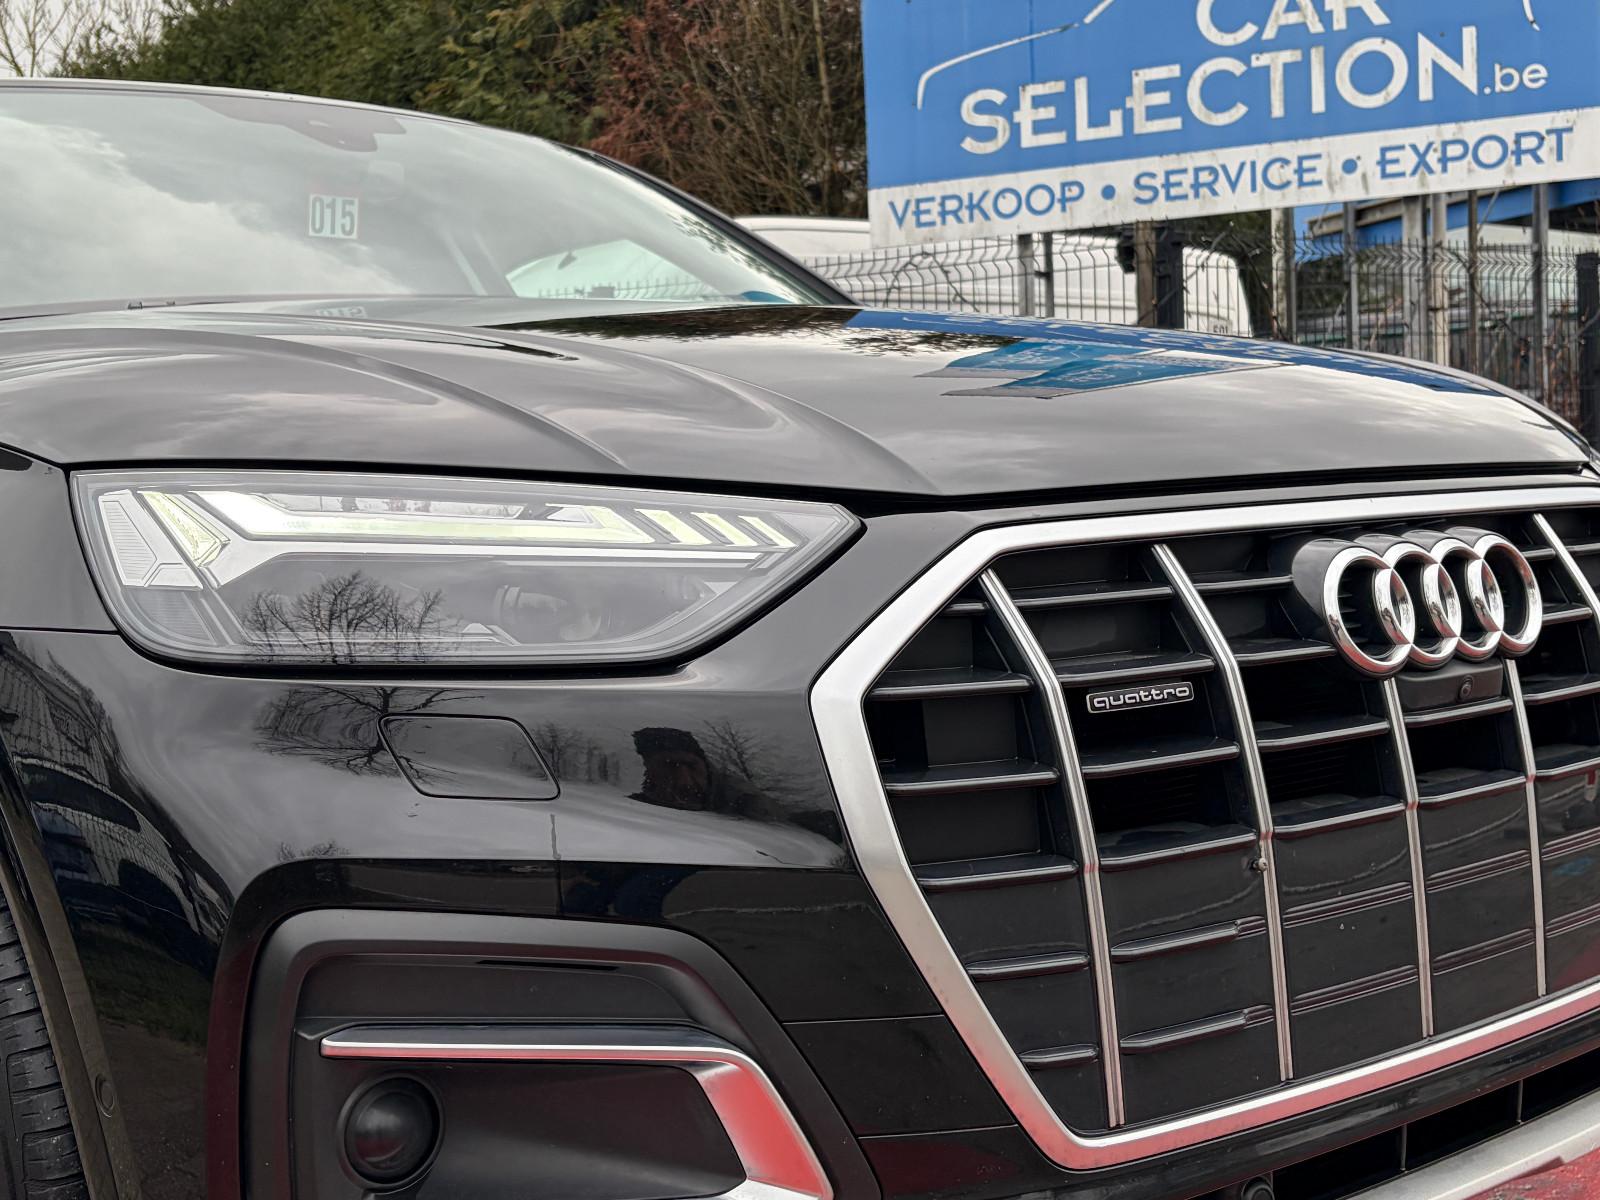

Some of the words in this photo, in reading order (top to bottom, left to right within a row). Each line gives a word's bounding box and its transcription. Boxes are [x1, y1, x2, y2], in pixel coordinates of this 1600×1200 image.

[960, 26, 1548, 154] SELECTION.be
[888, 181, 1085, 230] VERKOOP
[1133, 153, 1323, 205] SERVICE
[1376, 126, 1574, 180] EXPORT
[310, 195, 355, 237] 015
[1093, 686, 1190, 709] quattro
